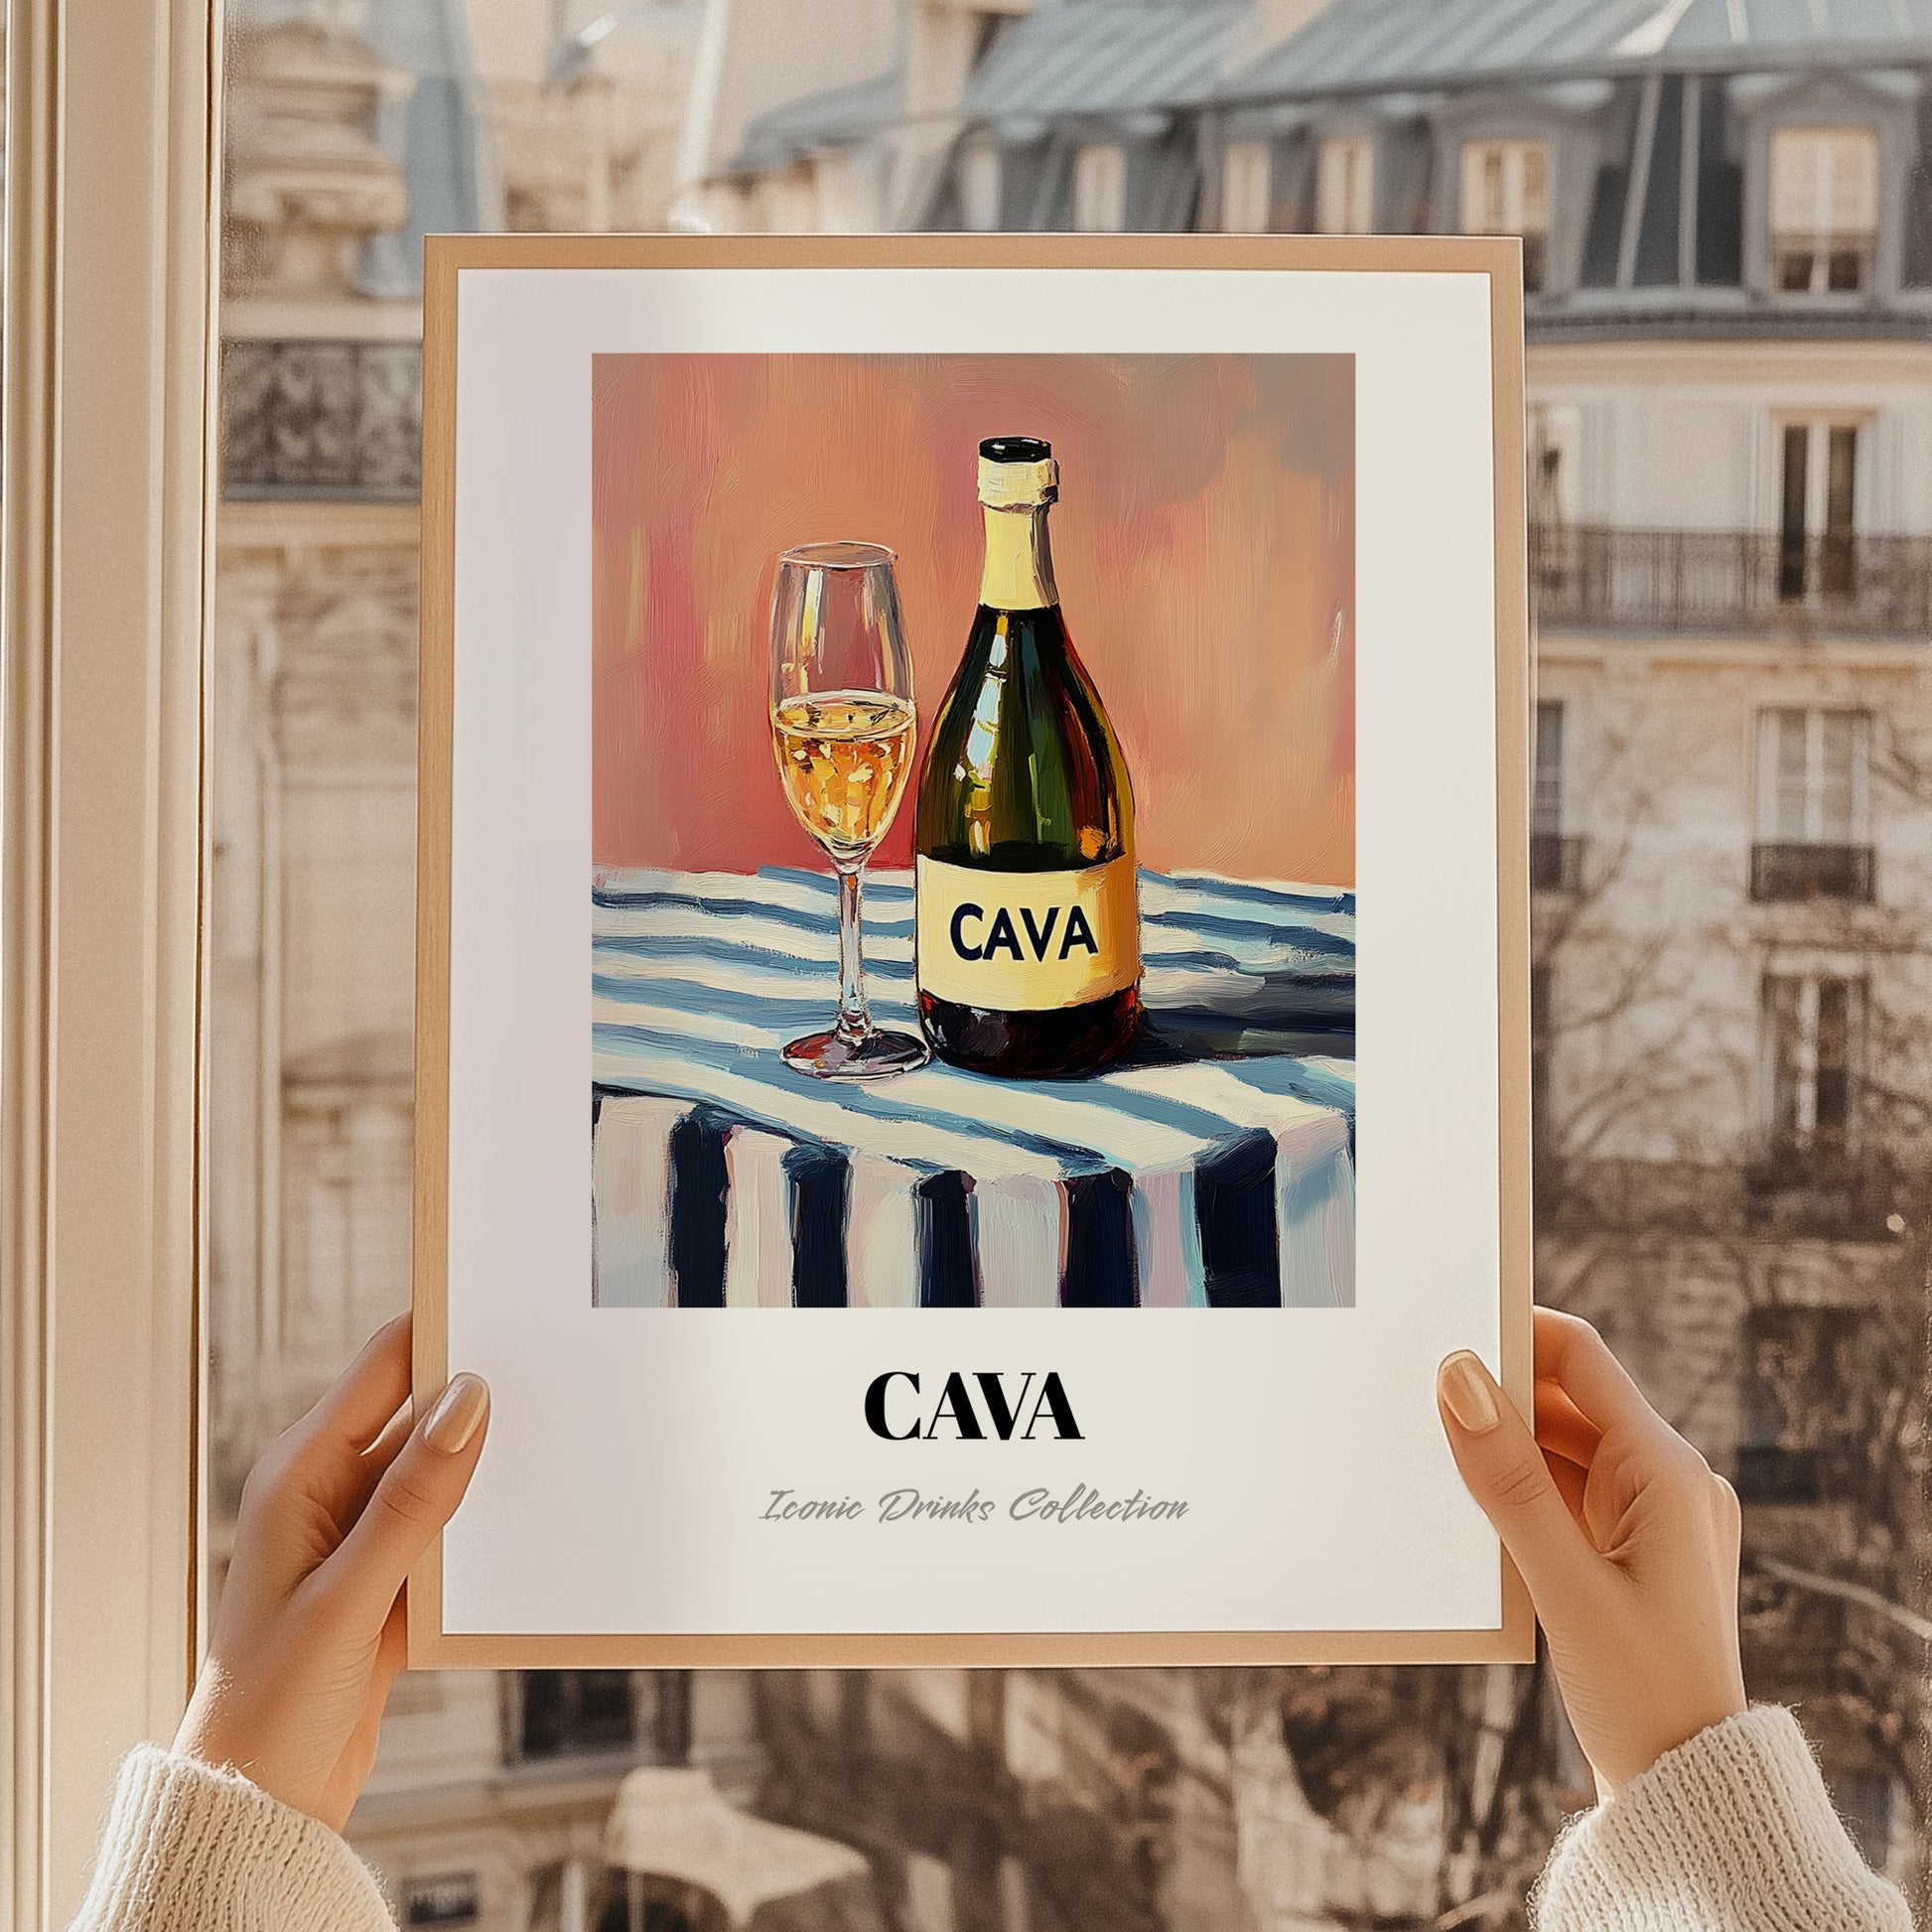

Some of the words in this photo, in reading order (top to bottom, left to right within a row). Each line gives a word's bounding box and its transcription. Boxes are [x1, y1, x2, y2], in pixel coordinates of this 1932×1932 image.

[950, 902, 1099, 962] CAVA
[864, 1371, 1086, 1442] CAVA
[759, 1488, 866, 1522] Iconic
[878, 1488, 996, 1523] Drinks
[1009, 1482, 1190, 1523] Collection
